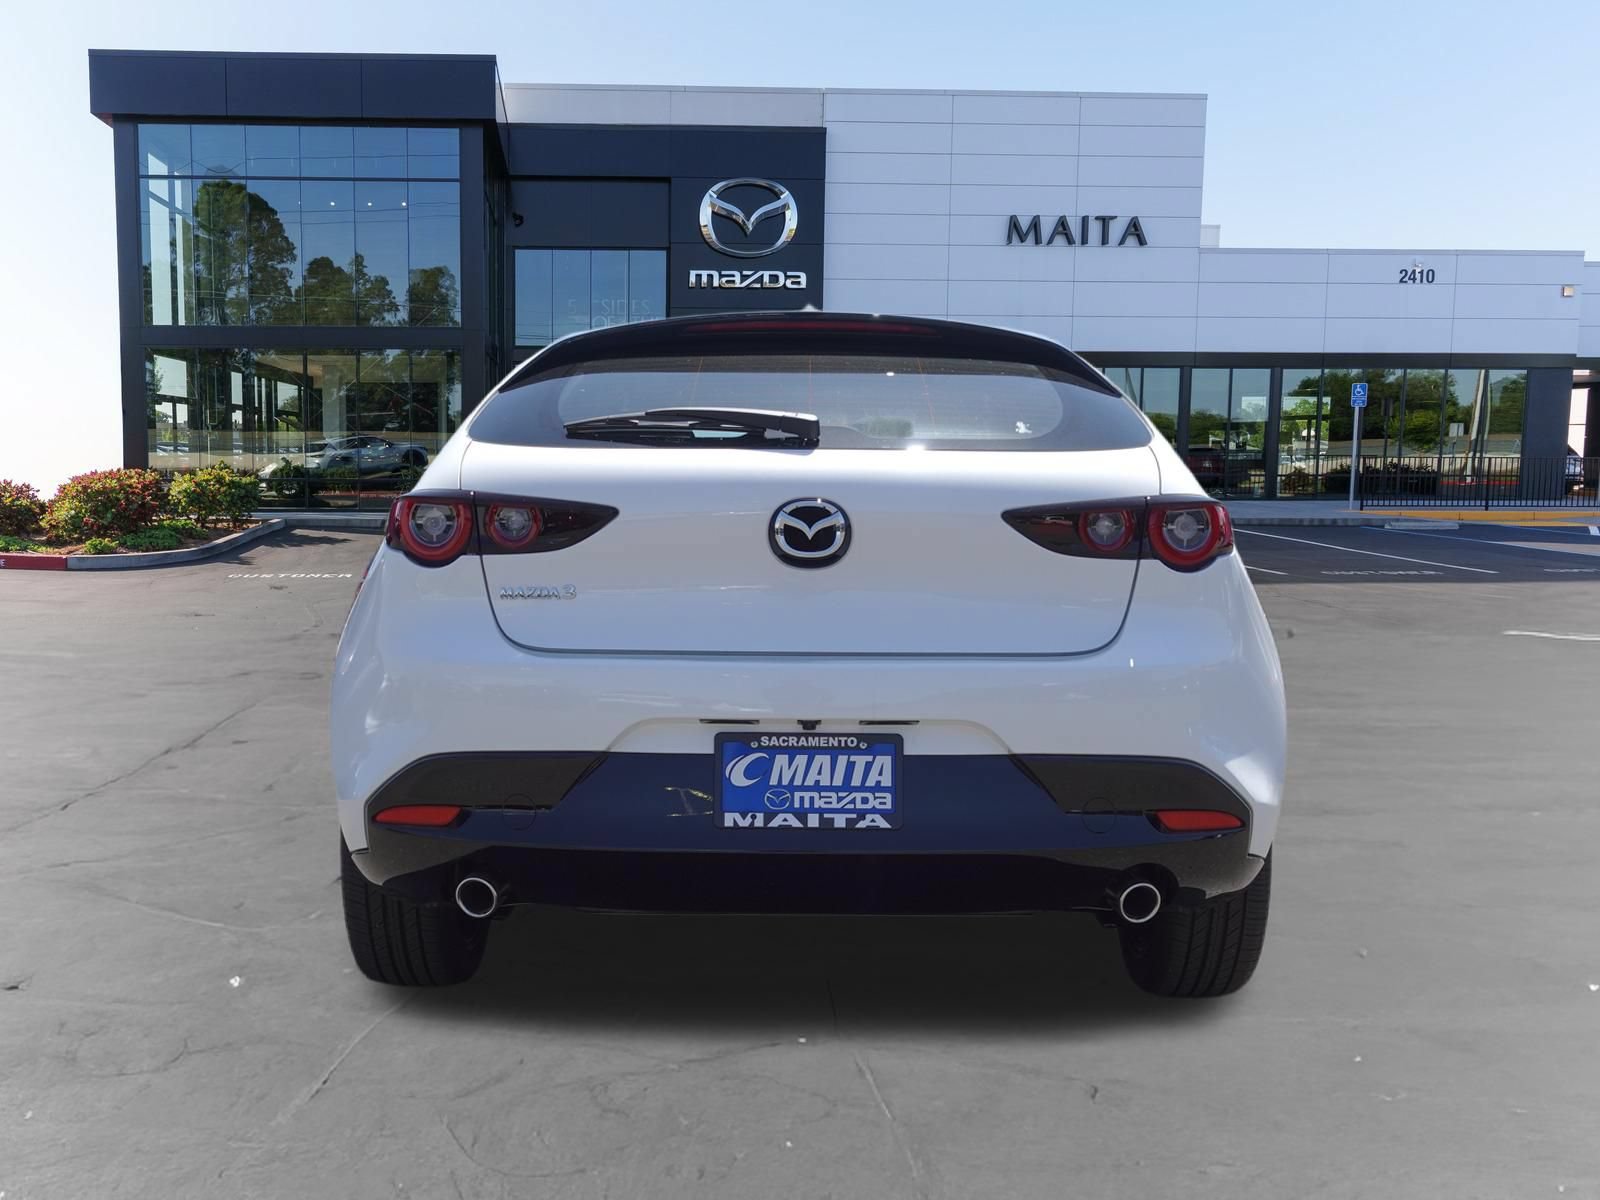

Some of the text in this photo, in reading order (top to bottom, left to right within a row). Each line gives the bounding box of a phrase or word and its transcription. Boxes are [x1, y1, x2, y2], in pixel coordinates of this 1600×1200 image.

[1006, 214, 1148, 246] MAITA
[688, 269, 807, 289] mazda
[1399, 268, 1436, 284] 2410
[760, 736, 858, 748] SACRAMENTO
[769, 754, 892, 787] MAITA
[793, 791, 892, 809] mazda
[724, 812, 892, 828] MAITA
